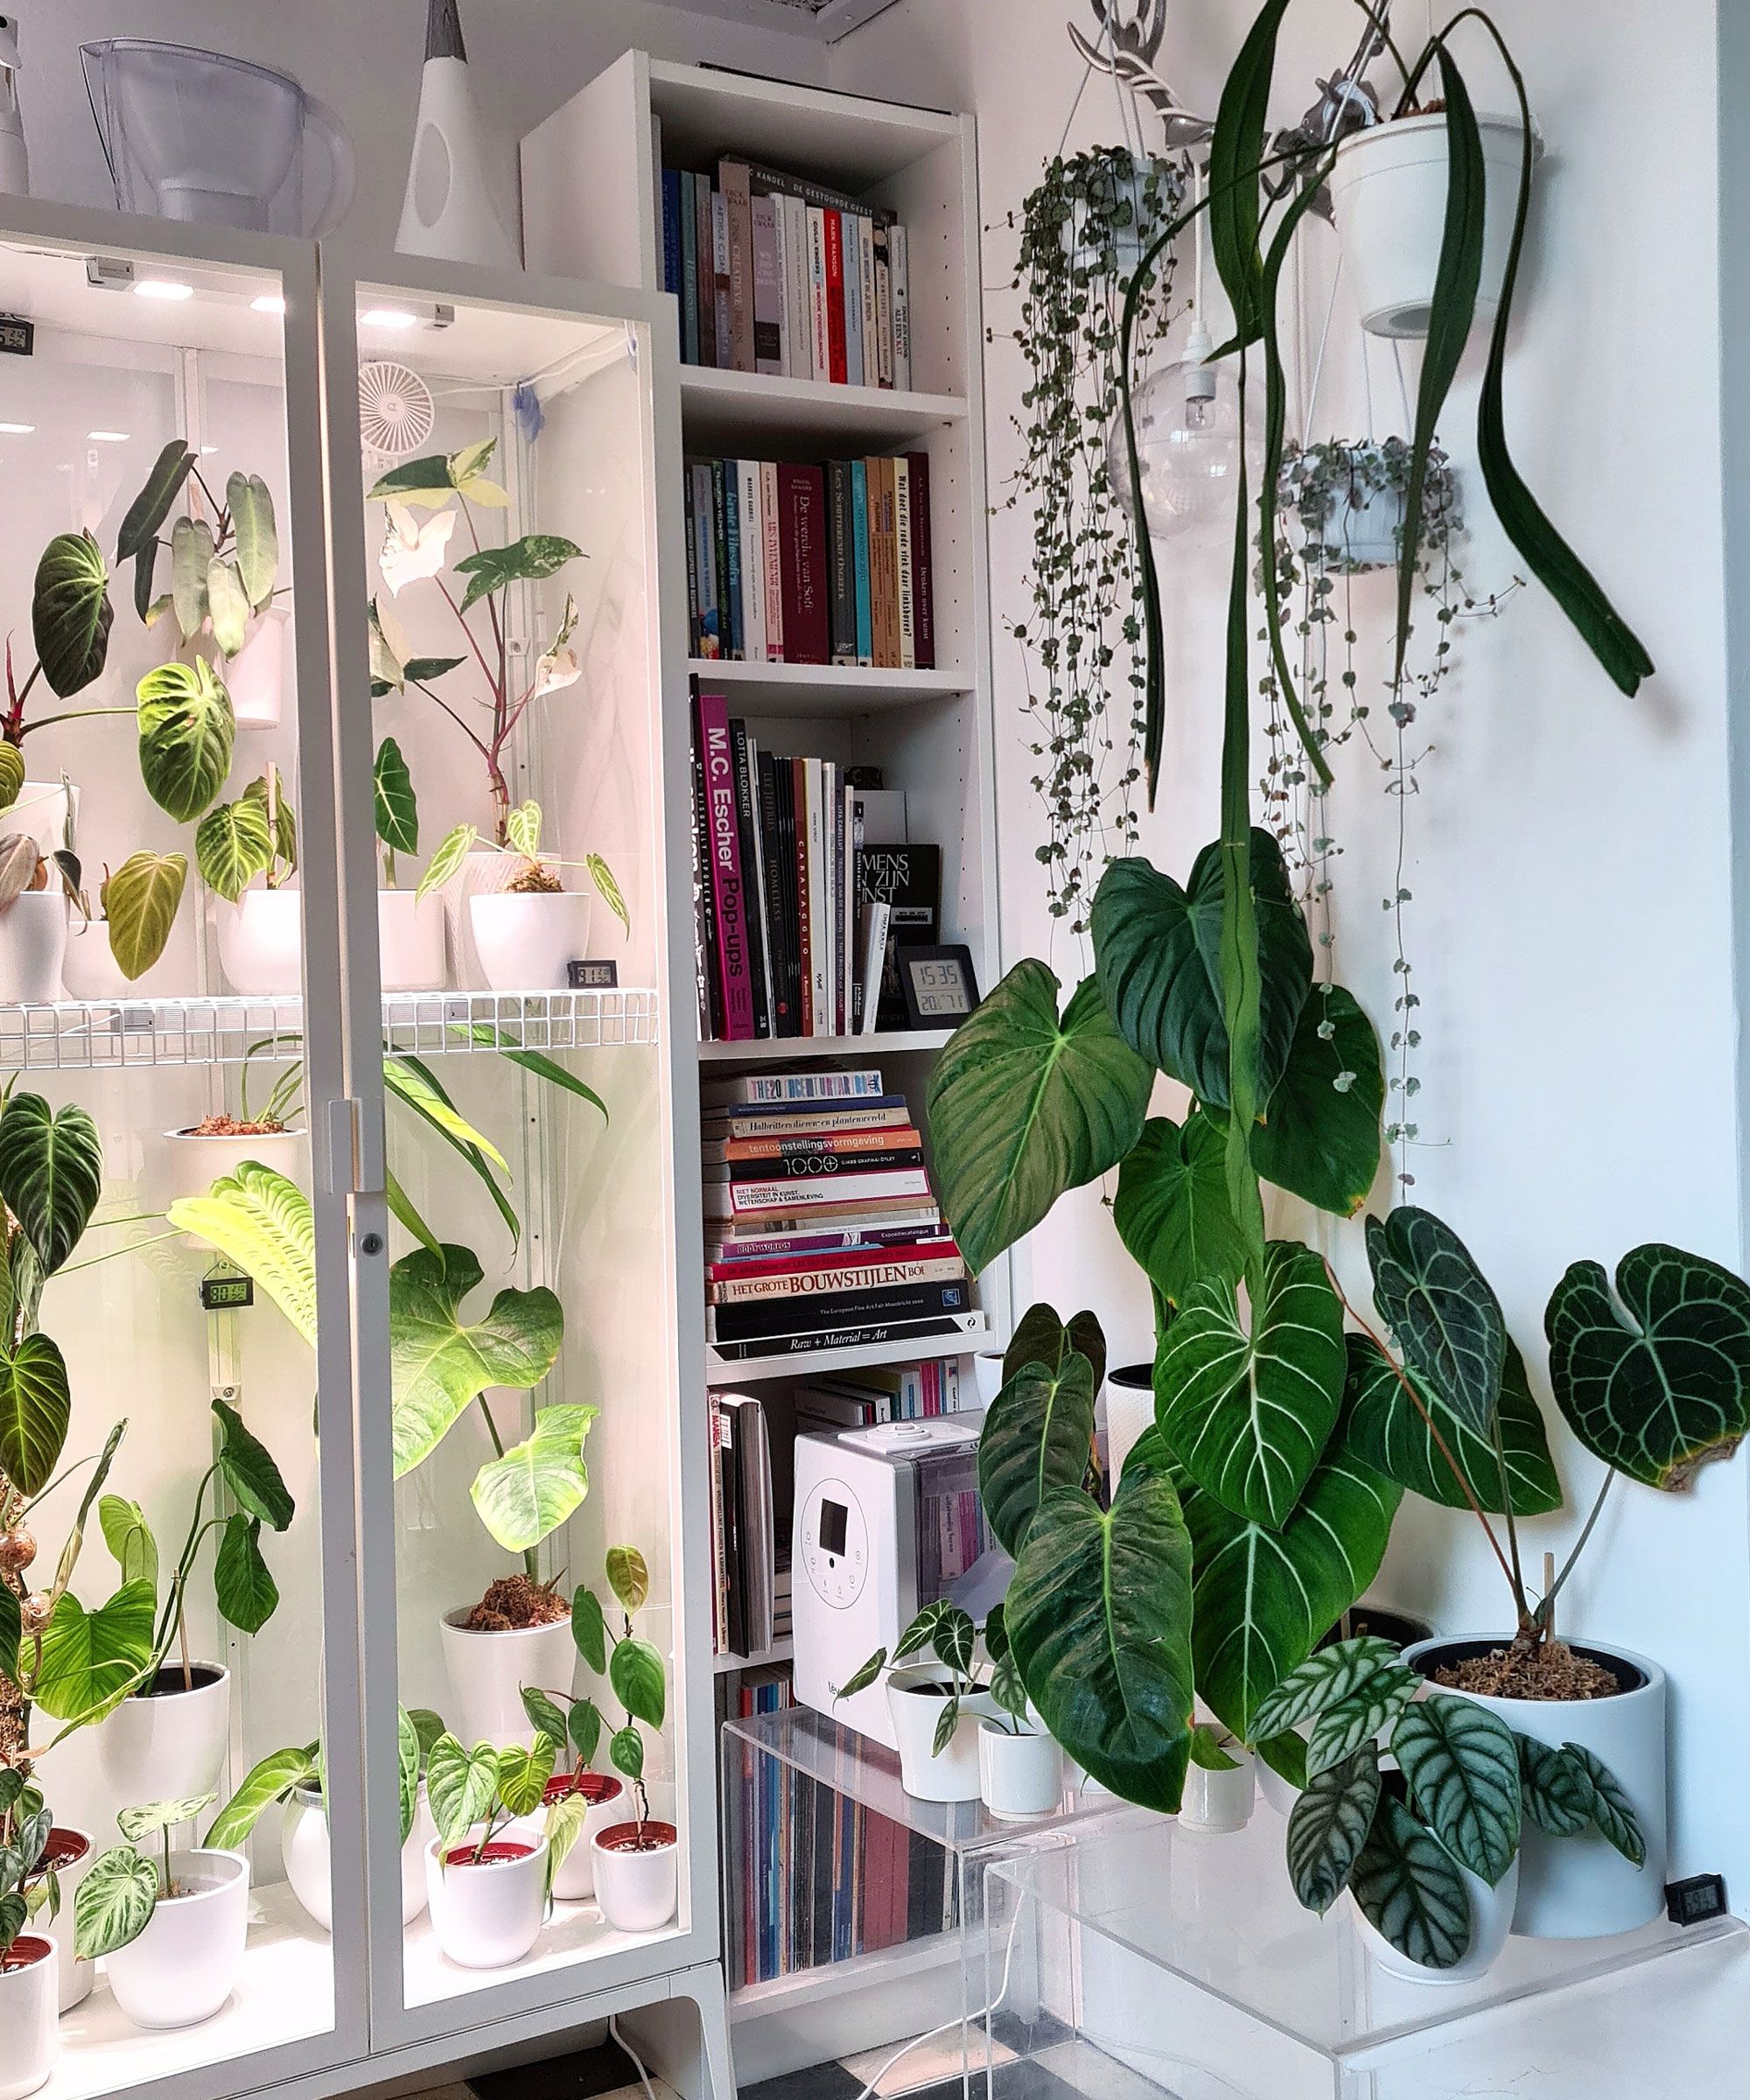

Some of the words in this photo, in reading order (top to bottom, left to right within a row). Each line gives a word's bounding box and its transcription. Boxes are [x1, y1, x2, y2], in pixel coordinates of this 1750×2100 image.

[793, 184, 803, 193] DE
[805, 187, 849, 209] GESTOORDE
[850, 203, 874, 216] GEEST
[715, 205, 724, 241] ARTHUR
[830, 242, 838, 276] MANSON
[901, 324, 907, 333] EN
[898, 474, 906, 491] Wat
[725, 490, 738, 527] Grote
[799, 494, 810, 511] De
[898, 492, 907, 512] doet
[767, 521, 777, 537] ARS
[899, 513, 908, 528] die
[900, 528, 909, 548] rode
[727, 528, 741, 585] Filosofen
[900, 550, 910, 568] vlek
[802, 561, 810, 581] van
[900, 569, 910, 588] daar
[689, 589, 697, 618] BEGINNERS
[900, 589, 913, 639] linksboven?
[706, 725, 730, 781] M.C.
[734, 731, 746, 764] LOTTA
[738, 766, 751, 818] BLOKKER
[763, 789, 776, 832] JEFFRIES
[711, 787, 738, 871] Escher
[697, 791, 707, 851] VISUALLY
[702, 858, 710, 903] SPOKEN
[863, 854, 909, 871] MENS
[768, 858, 781, 921] HOMELESS
[876, 872, 910, 887] ZIJN
[797, 840, 809, 956] CARAVAGGIO
[837, 899, 844, 907] DE
[718, 876, 747, 978] Pop-ups
[749, 1118, 794, 1131] Halbritters
[831, 1111, 886, 1126] plantenwereld
[747, 1134, 885, 1153] tentoonstellingsvormgeving
[738, 1196, 778, 1205] WETENSCHAP
[784, 1192, 824, 1201] SAMENLEVING
[732, 1283, 753, 1295] HET
[753, 1279, 788, 1293] GROTE
[788, 1264, 907, 1295] BOUWSTIJLEN
[830, 1306, 854, 1315] European
[788, 1337, 811, 1350] Raw
[813, 1338, 821, 1347] +
[822, 1330, 861, 1346] Material
[870, 1327, 888, 1340] Art
[711, 1414, 720, 1447] MANGA
